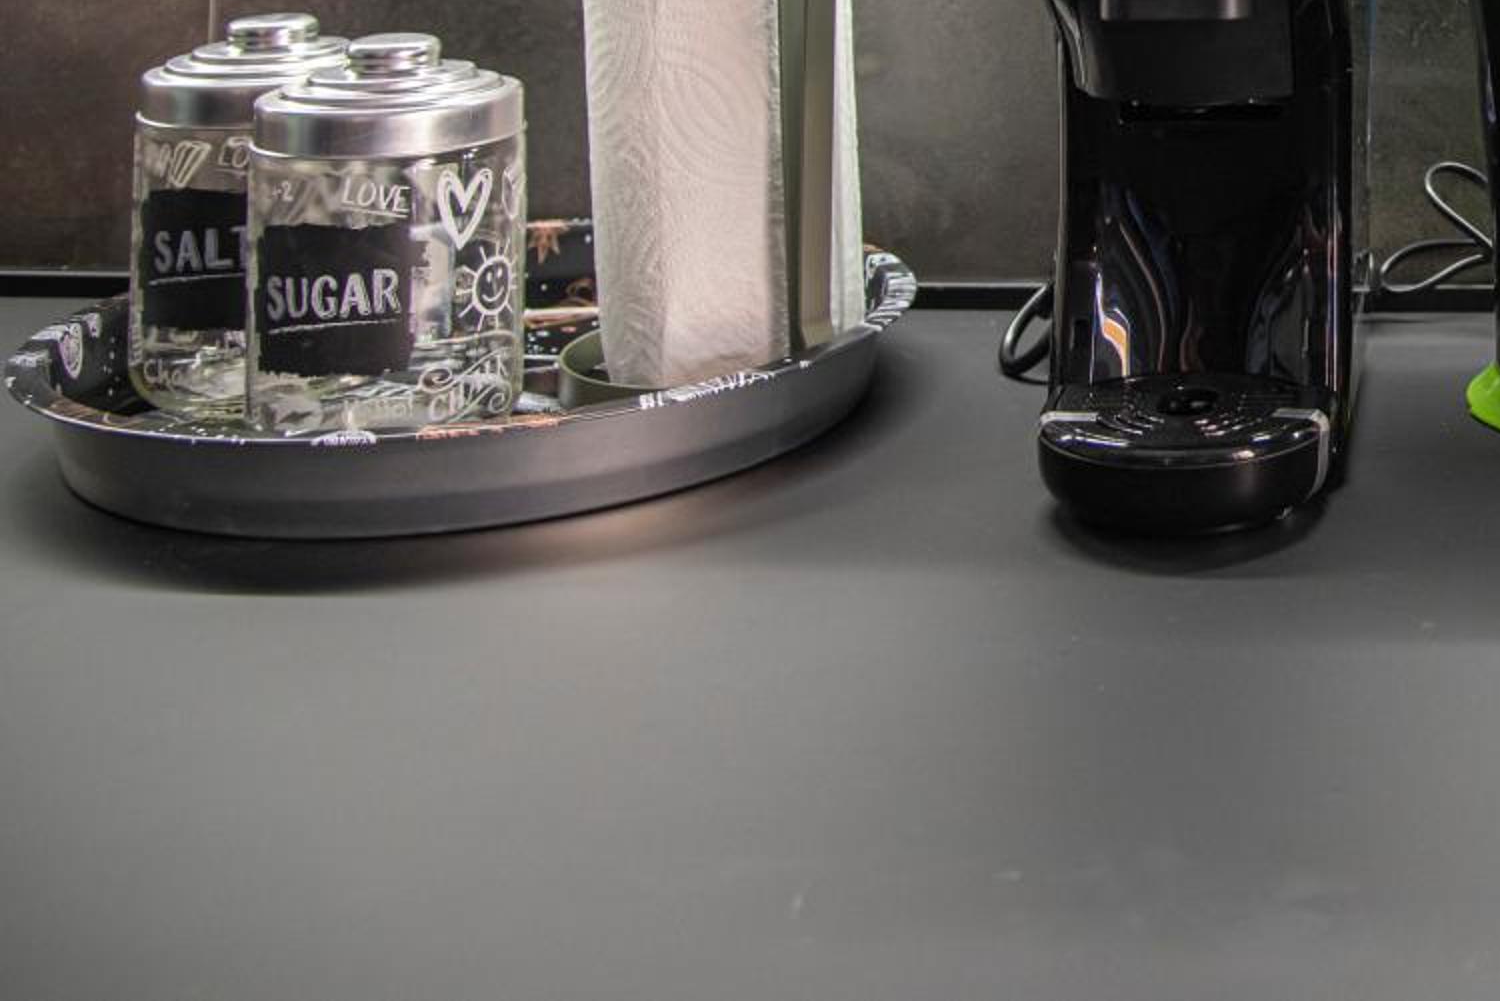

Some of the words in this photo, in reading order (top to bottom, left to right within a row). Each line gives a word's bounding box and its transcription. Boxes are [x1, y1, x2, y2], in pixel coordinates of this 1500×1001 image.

[341, 176, 411, 212] LOVE
[154, 225, 248, 273] SALT
[266, 268, 402, 320] SUGAR
